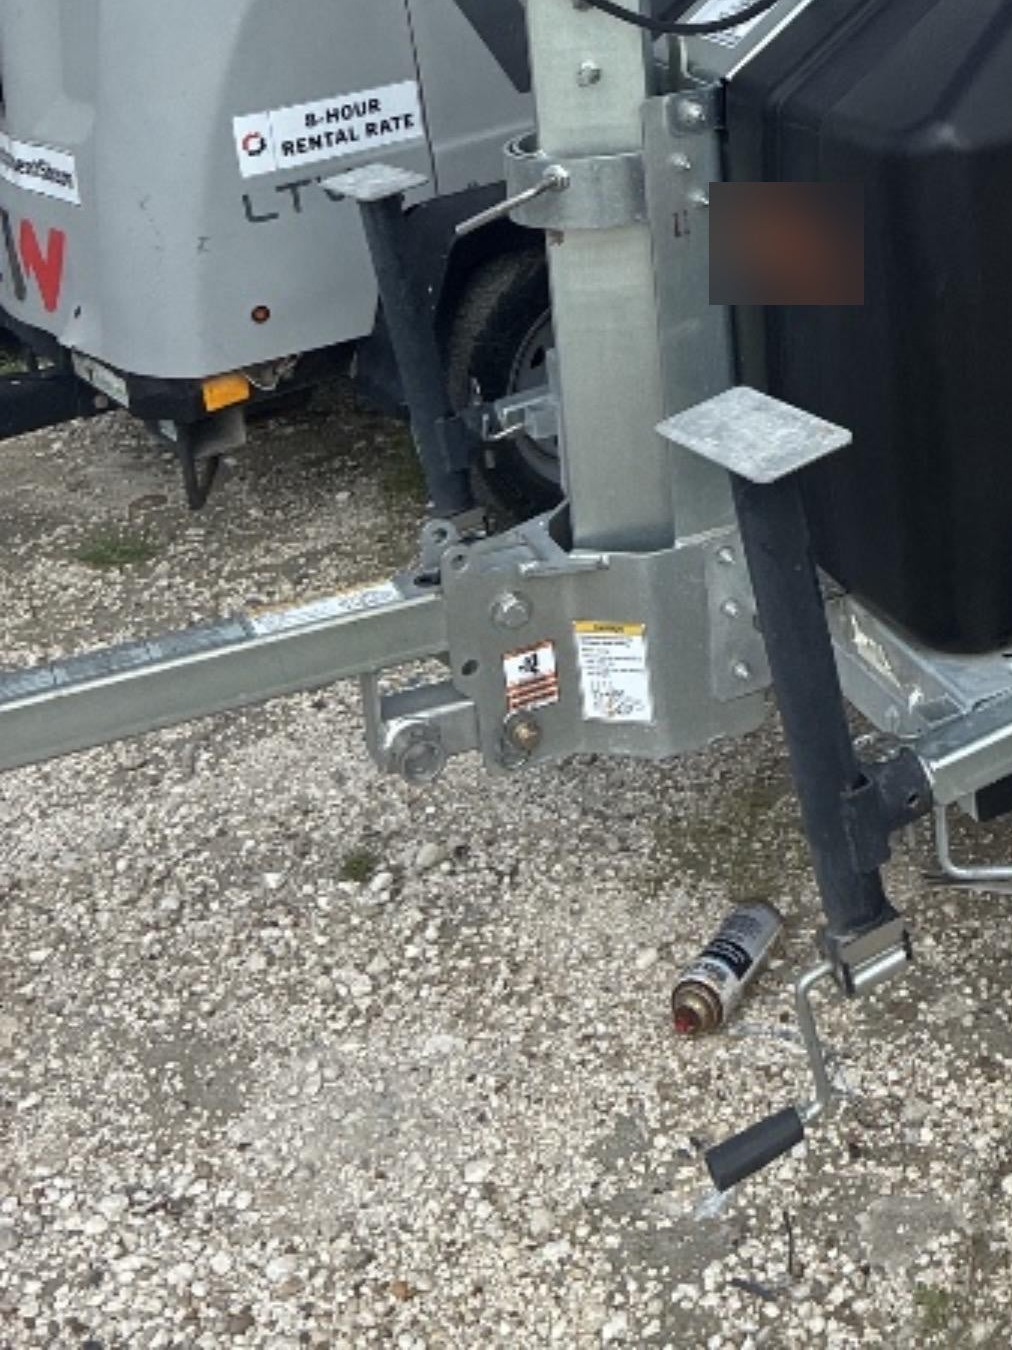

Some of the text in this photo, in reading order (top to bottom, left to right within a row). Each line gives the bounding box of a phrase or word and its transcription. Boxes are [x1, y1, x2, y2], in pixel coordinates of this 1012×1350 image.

[304, 98, 382, 128] 8-HOUR
[281, 113, 415, 157] RENTAL RATE
